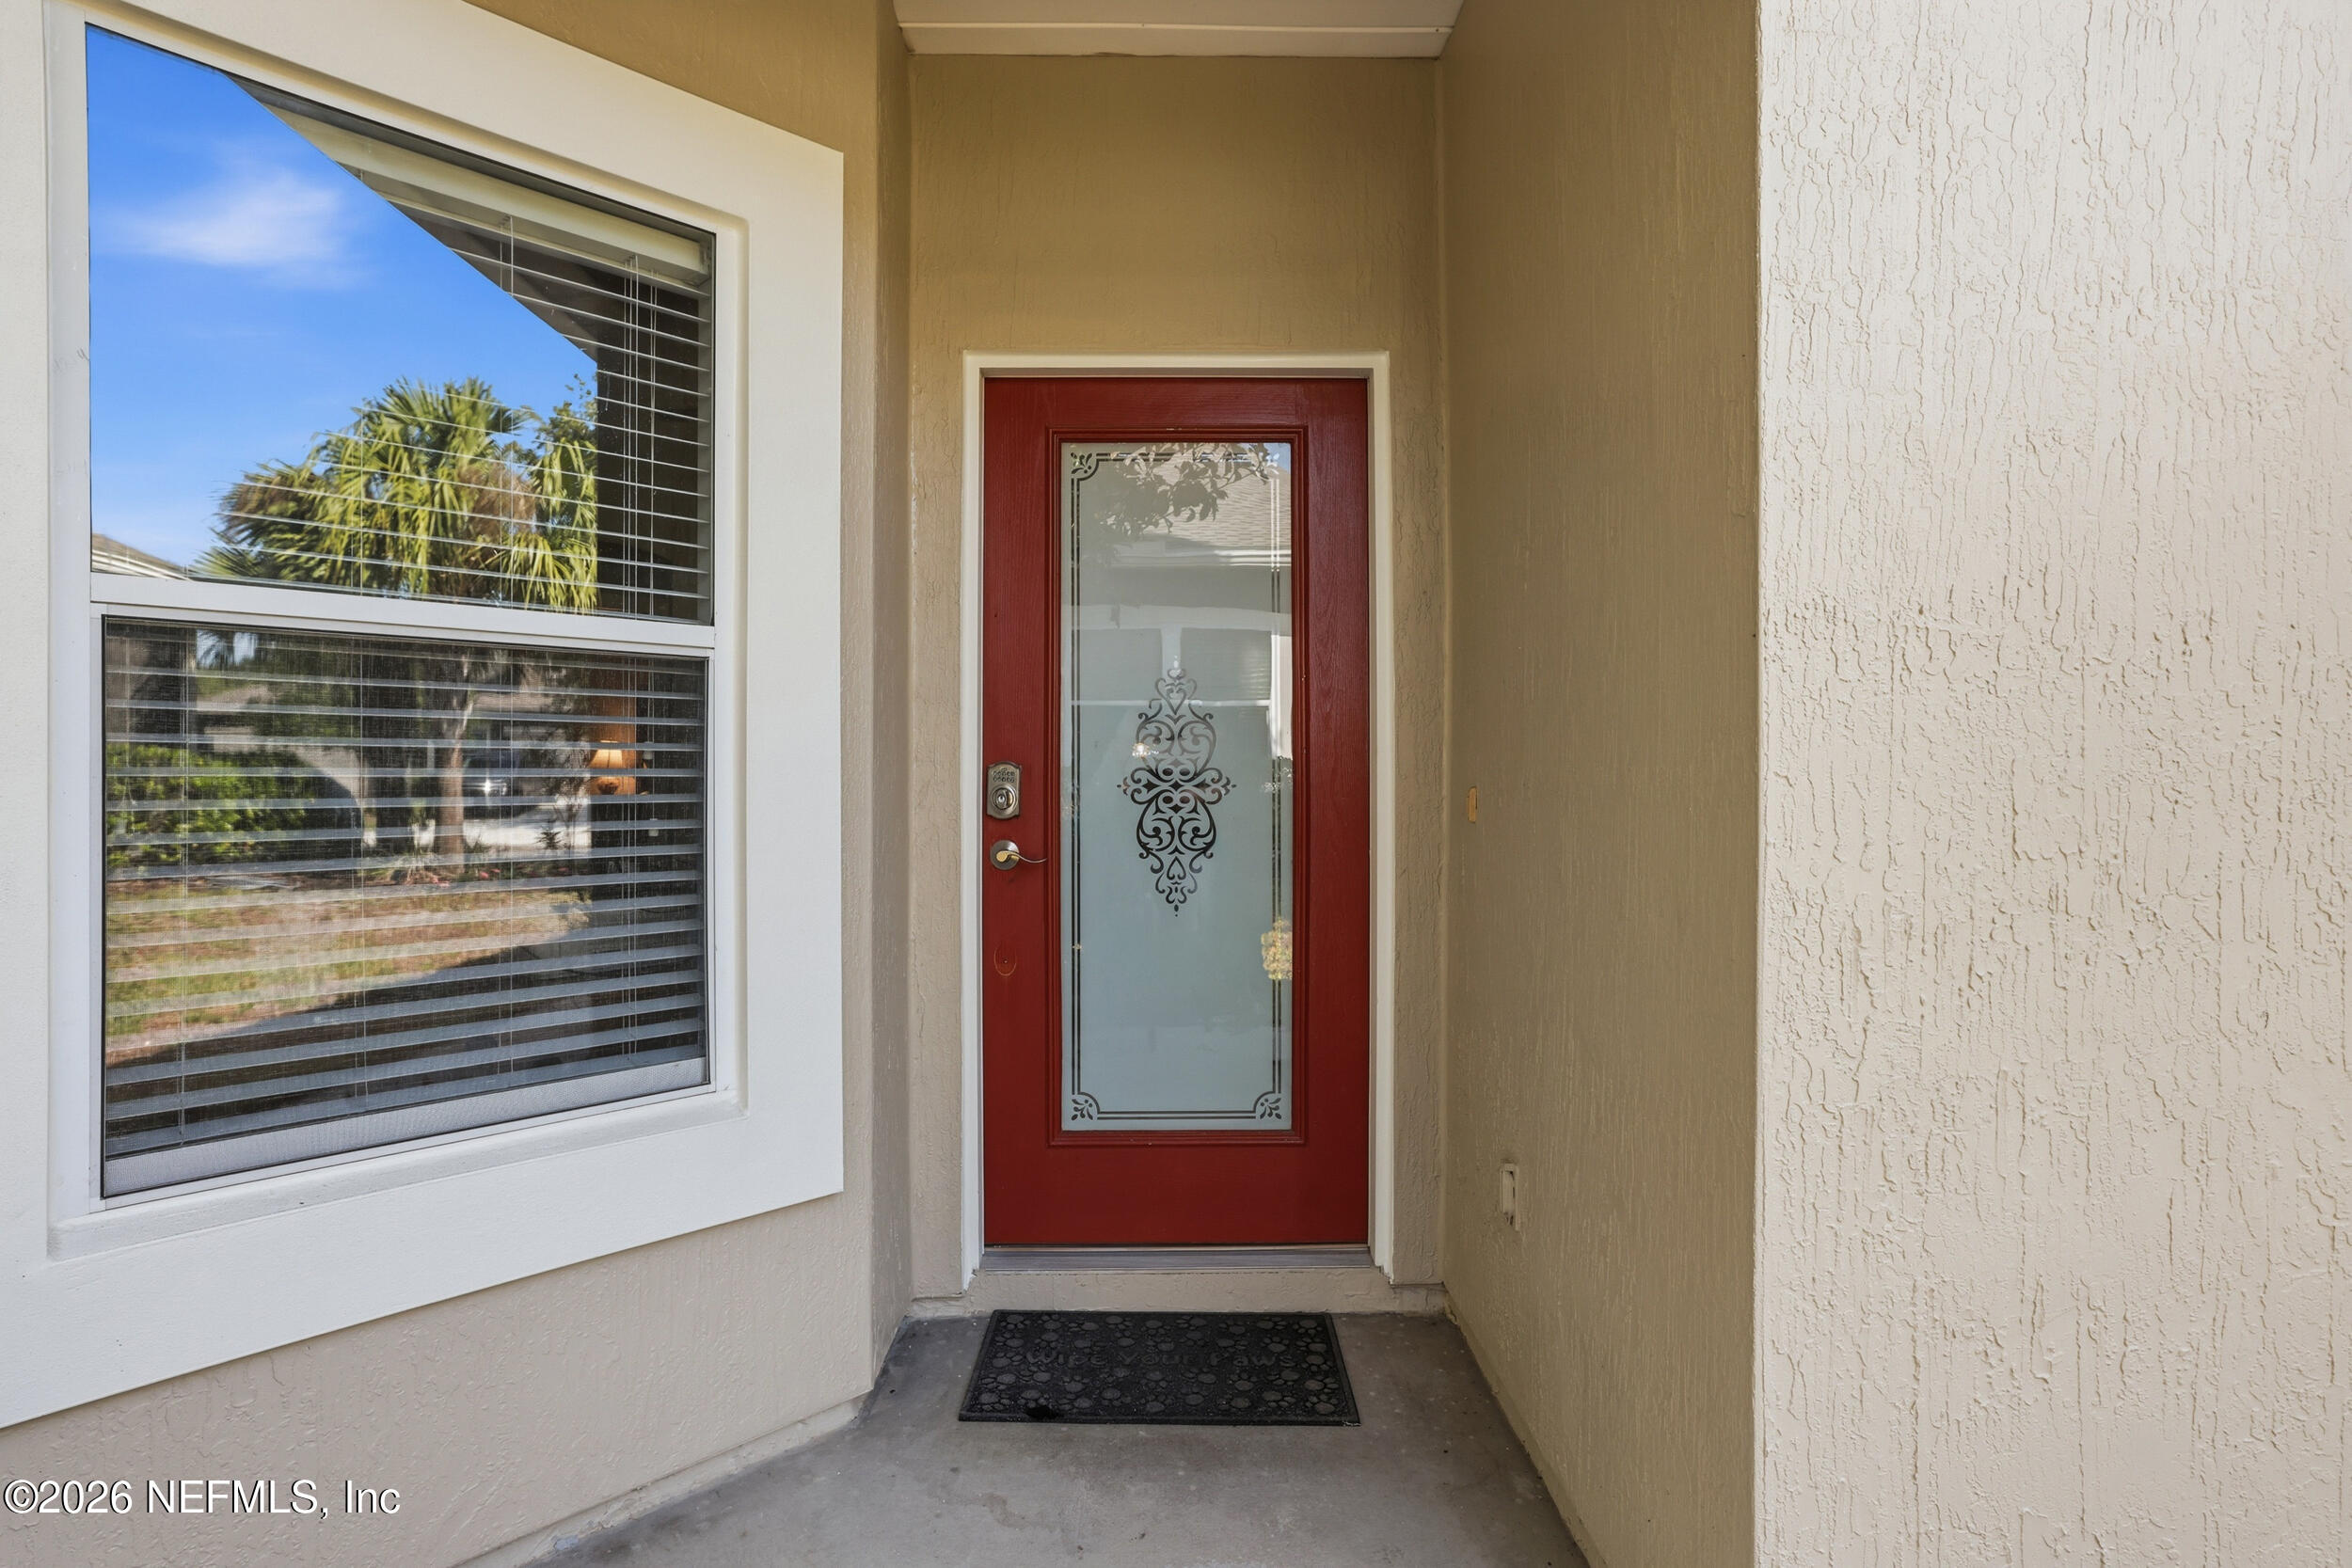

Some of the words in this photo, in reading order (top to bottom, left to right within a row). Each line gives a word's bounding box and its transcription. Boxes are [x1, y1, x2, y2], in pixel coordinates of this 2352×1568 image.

[1025, 1351, 1107, 1368] Wipe
[1117, 1351, 1197, 1367] Your
[1210, 1351, 1295, 1367] Paws
